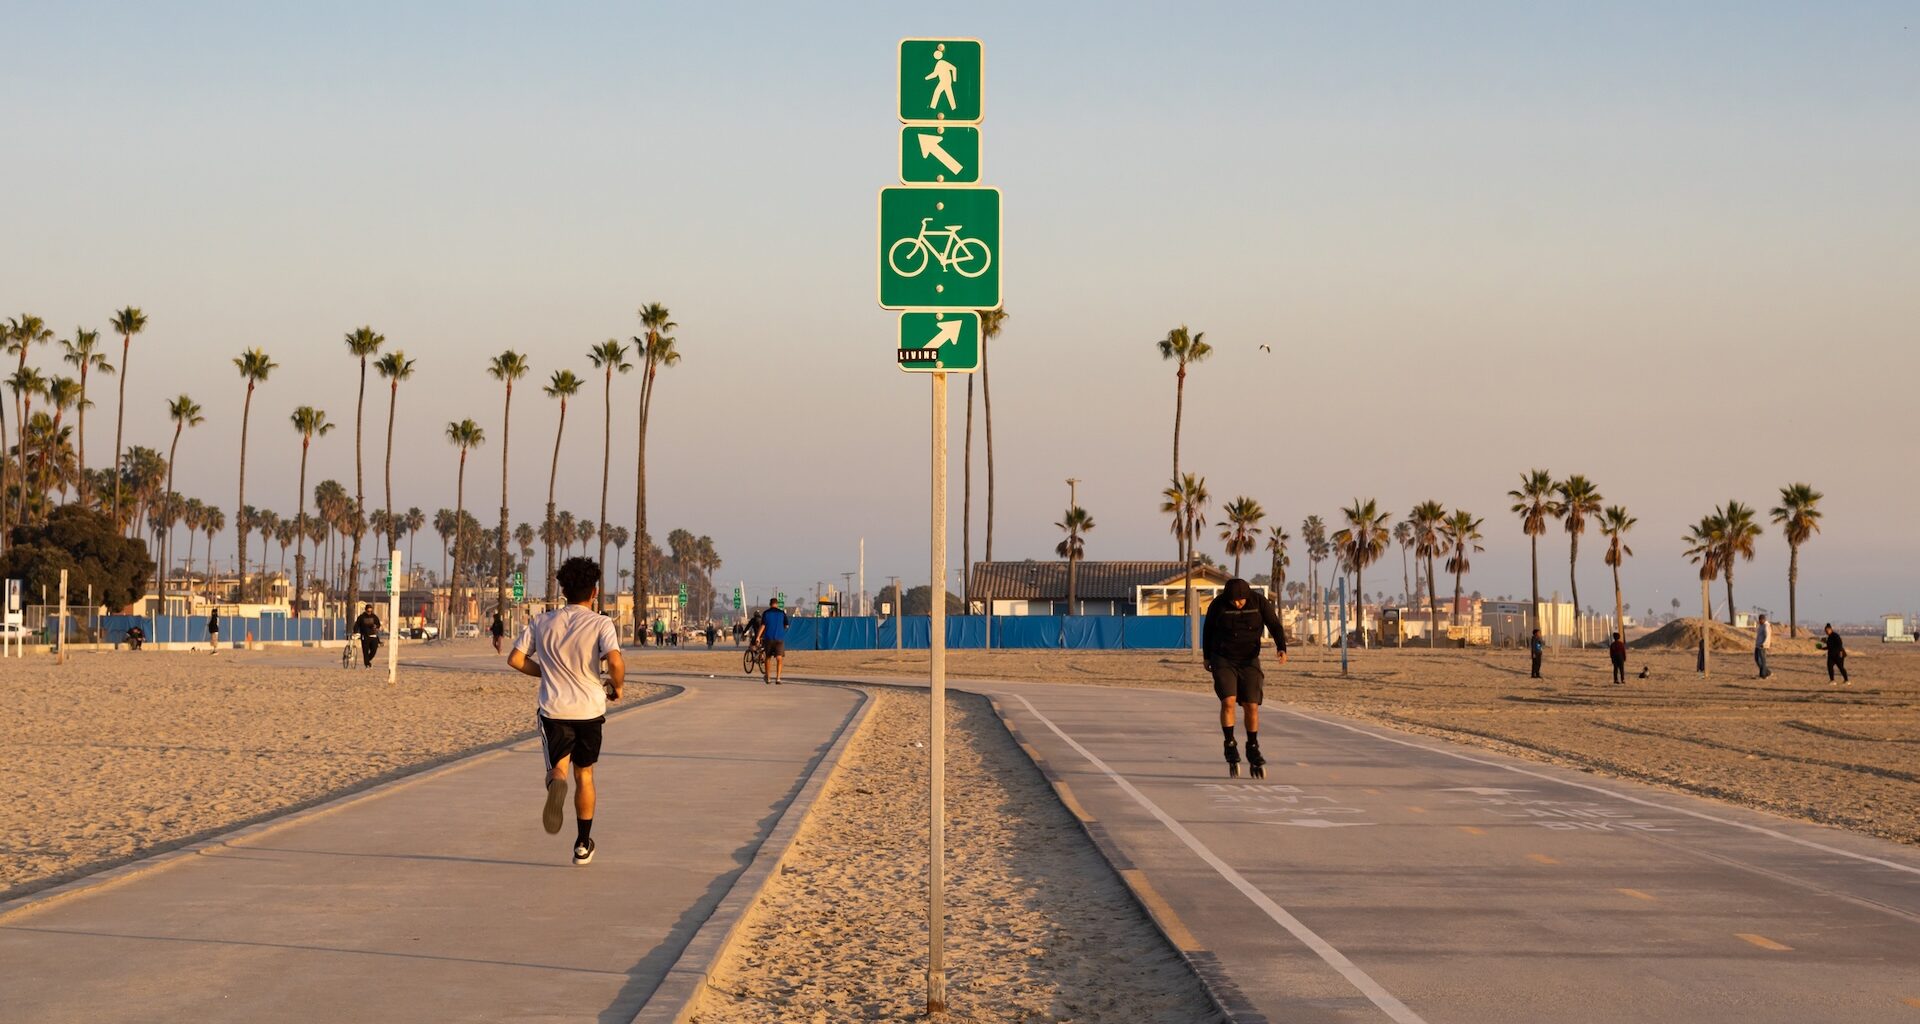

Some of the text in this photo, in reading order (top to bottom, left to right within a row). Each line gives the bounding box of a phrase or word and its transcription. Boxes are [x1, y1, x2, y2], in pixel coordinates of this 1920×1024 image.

[899, 350, 937, 360] LIVING
[1193, 783, 1304, 793] BIKE
[1207, 794, 1340, 804] LANE
[1480, 807, 1635, 818] LANE
[1531, 820, 1677, 832] BIKE
